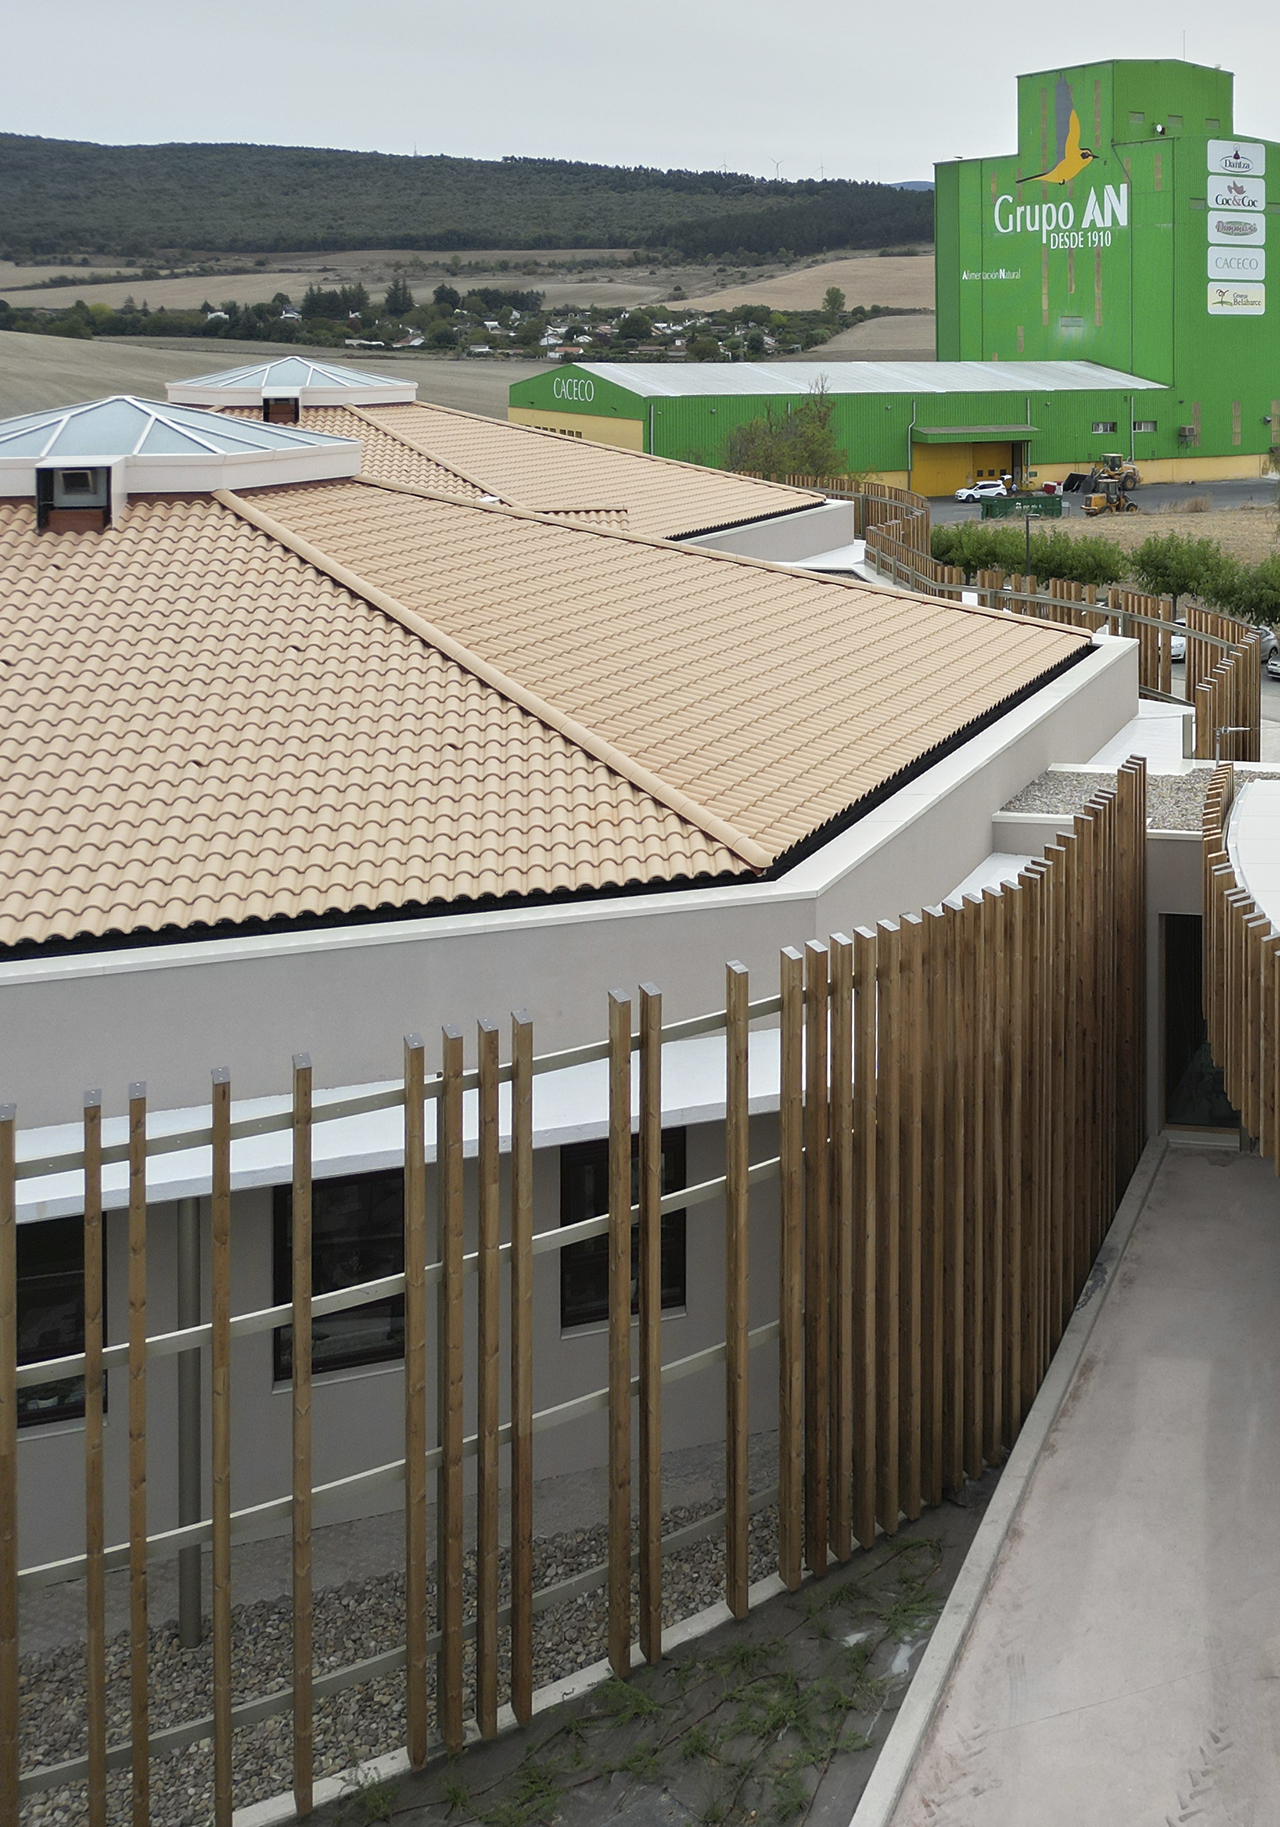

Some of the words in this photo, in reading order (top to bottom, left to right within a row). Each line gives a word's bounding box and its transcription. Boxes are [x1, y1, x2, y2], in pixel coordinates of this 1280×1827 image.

[1224, 159, 1250, 169] Dantza
[1215, 193, 1258, 207] Coc&Coc
[994, 194, 1075, 244] Grupo
[1081, 183, 1128, 228] AN
[1050, 232, 1084, 249] DESDE
[1087, 230, 1112, 247] 1910
[1215, 256, 1258, 270] CACECO
[553, 377, 595, 402] CACECO
